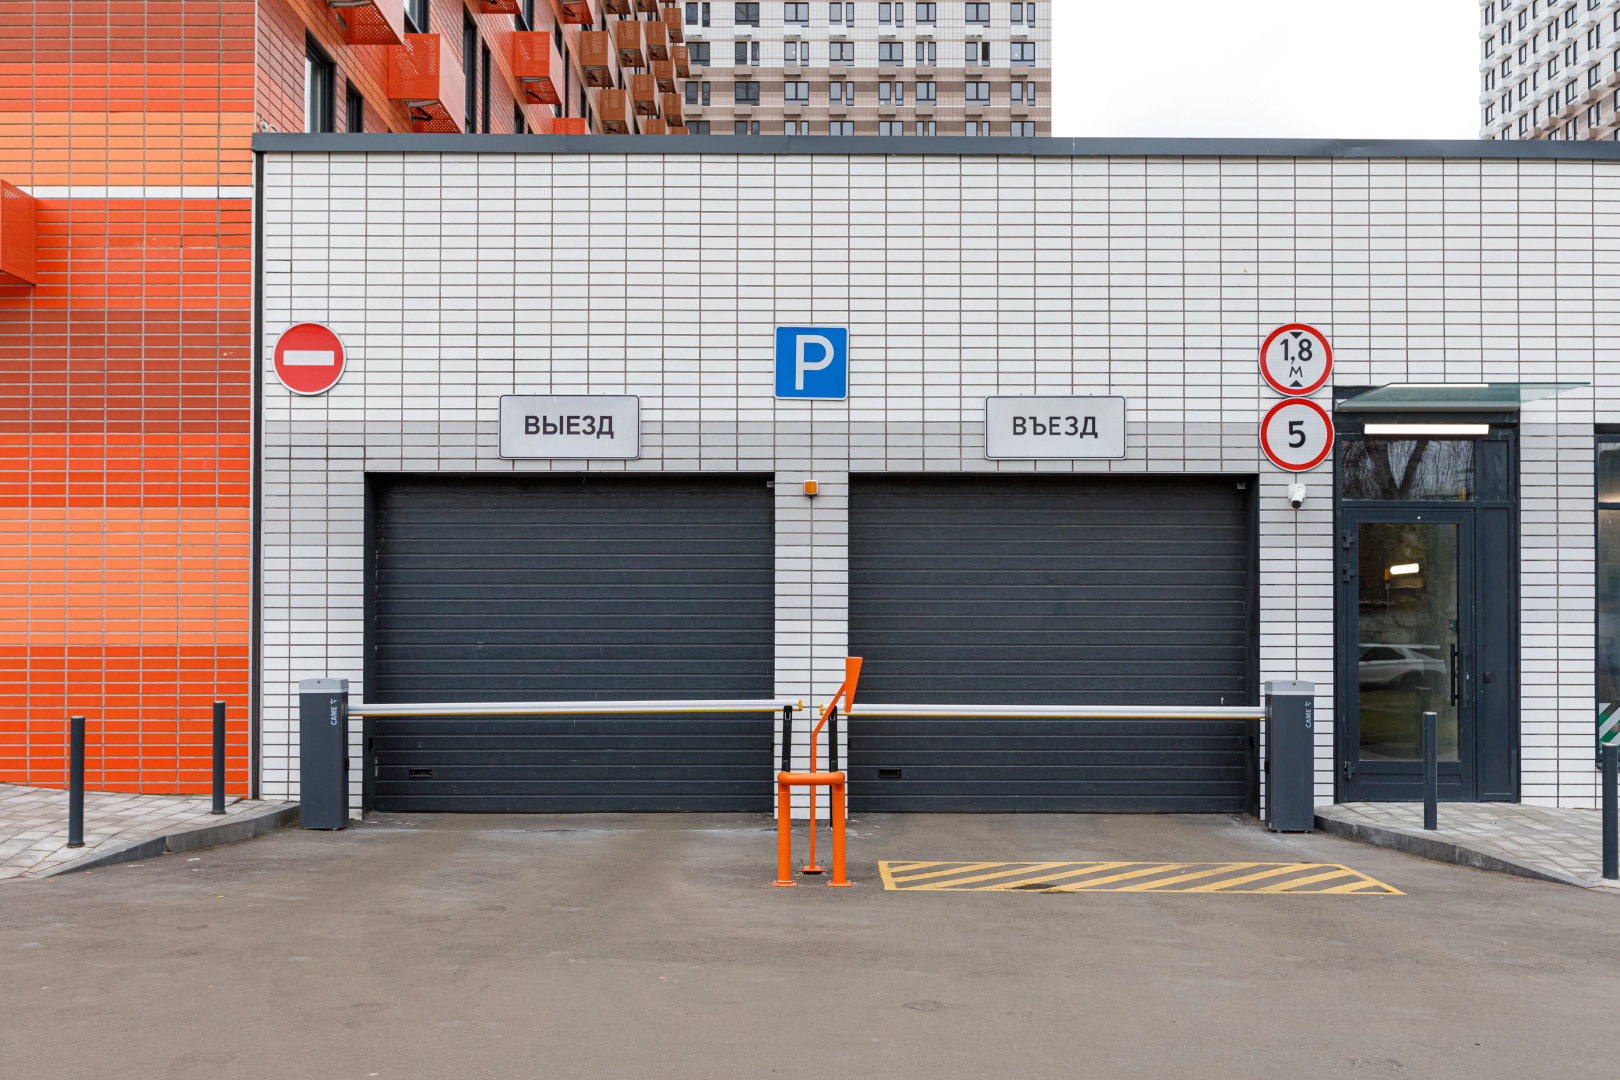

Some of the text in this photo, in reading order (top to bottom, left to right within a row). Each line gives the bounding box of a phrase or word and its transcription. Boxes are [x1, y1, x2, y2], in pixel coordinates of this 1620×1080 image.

[795, 334, 835, 391] P
[1280, 338, 1313, 365] 1,8
[524, 415, 615, 440] ВЫЕЗД
[1012, 415, 1099, 439] ВЪЕЗД
[1288, 420, 1306, 449] 5
[330, 706, 338, 726] CAME
